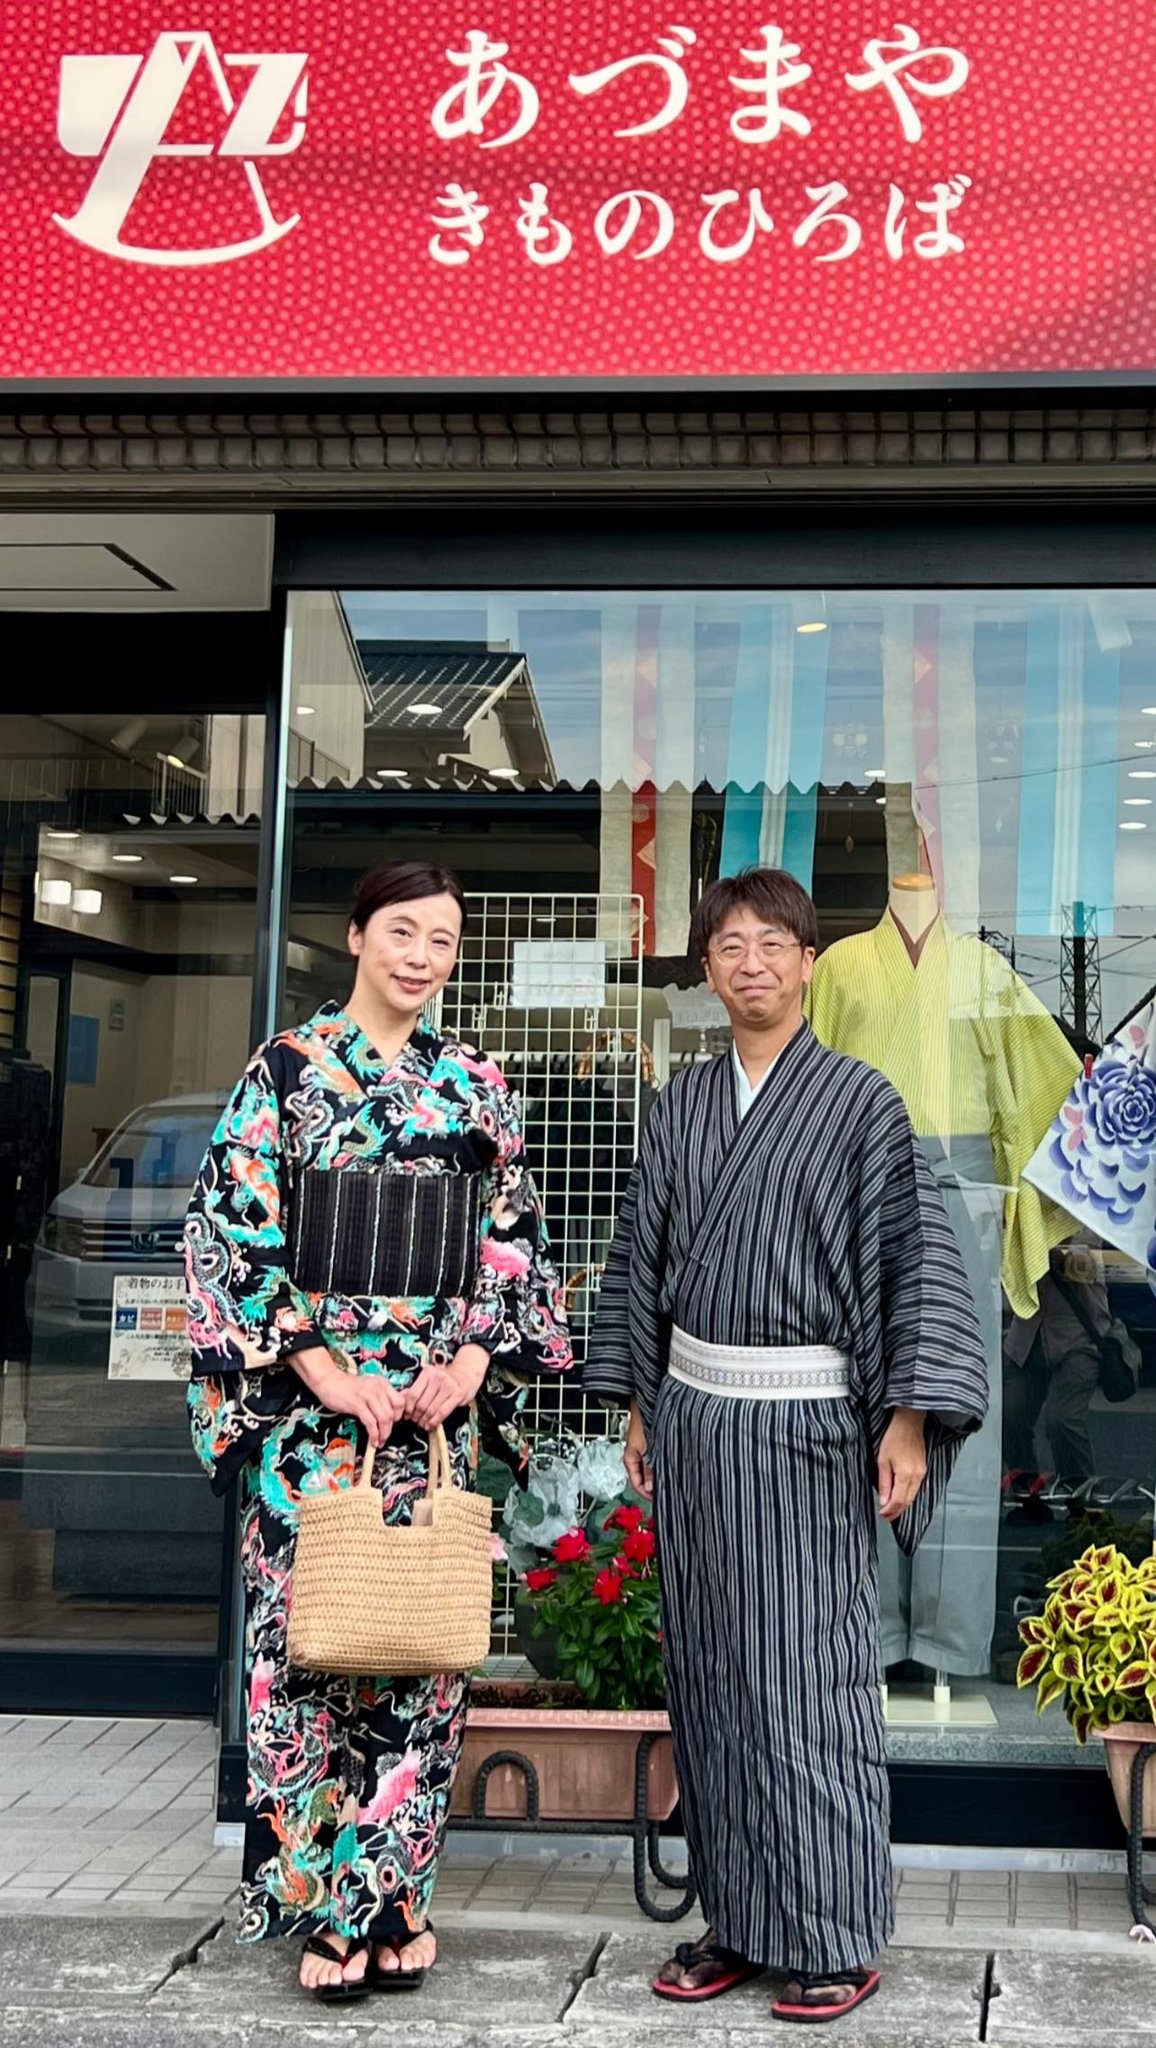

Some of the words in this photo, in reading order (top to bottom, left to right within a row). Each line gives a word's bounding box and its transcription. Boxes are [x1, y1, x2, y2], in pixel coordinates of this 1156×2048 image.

[430, 24, 970, 148] あづまや
[428, 173, 972, 266] きものひろば
